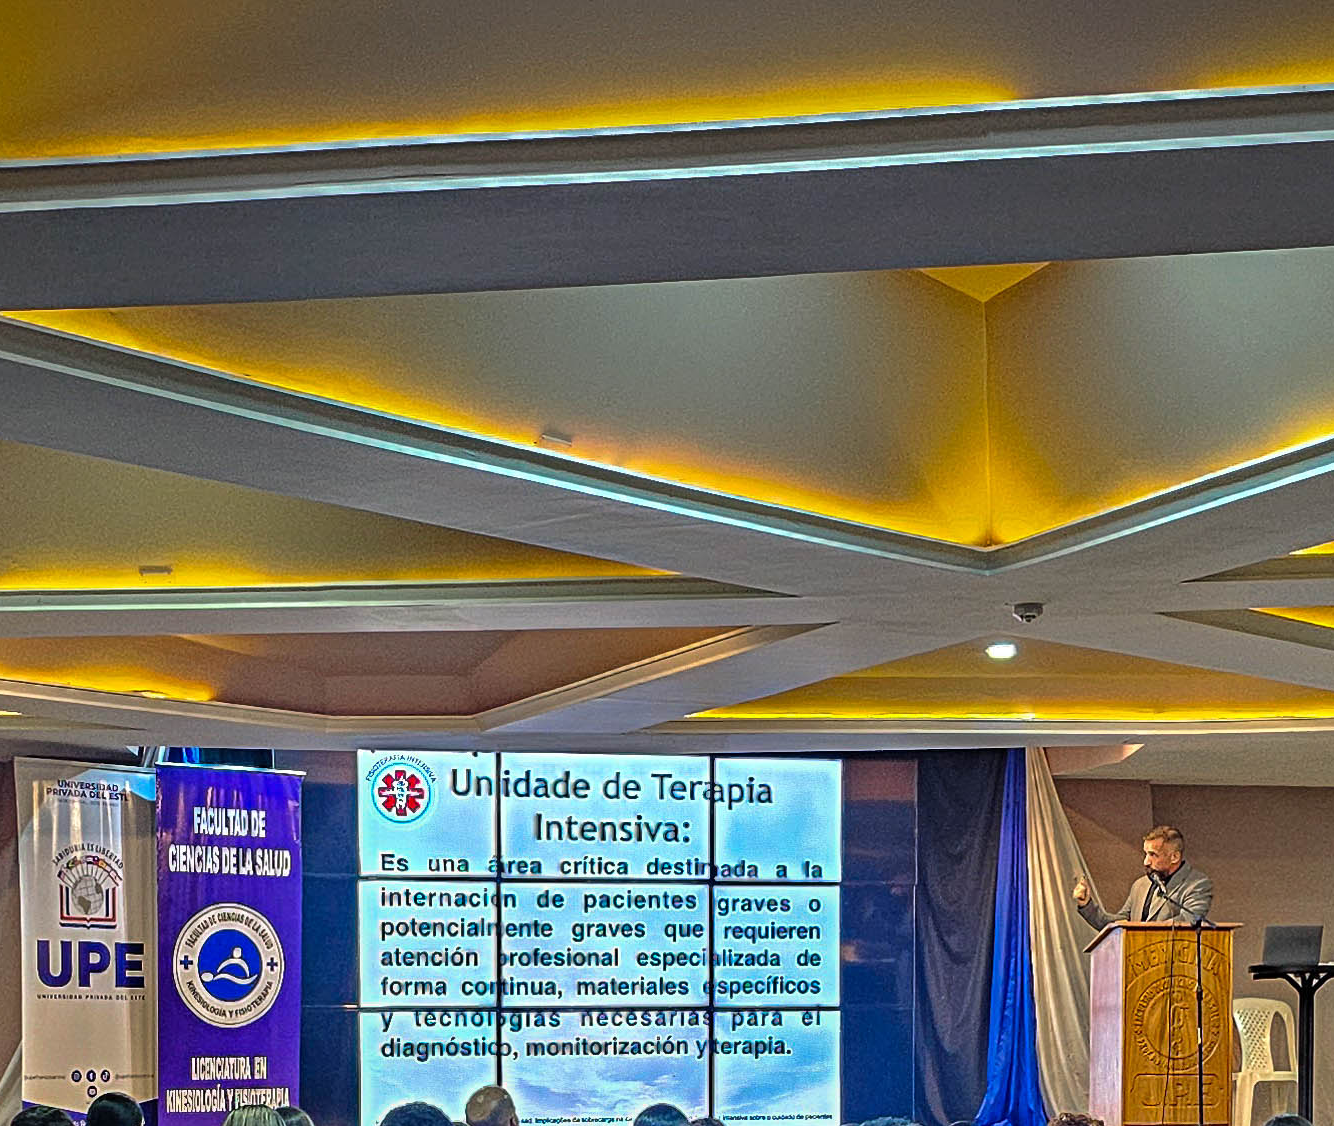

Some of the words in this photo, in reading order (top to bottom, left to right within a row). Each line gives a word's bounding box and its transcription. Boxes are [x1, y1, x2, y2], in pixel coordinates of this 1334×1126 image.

[46, 787, 87, 799] PRIVADA
[57, 779, 119, 792] UNIVERSIDAD
[451, 768, 591, 799] Unidade
[602, 771, 642, 800] de
[650, 773, 774, 811] Terapia
[193, 806, 248, 836] FACULTAD
[250, 809, 266, 838] DE
[534, 813, 691, 843] Intensiva:
[168, 843, 220, 874] CIENCIAS
[221, 846, 237, 875] DE
[238, 847, 254, 876] LA
[255, 848, 291, 877] SALUD
[380, 853, 409, 872] Es
[428, 857, 470, 872] una
[560, 855, 629, 876] crítica
[646, 857, 759, 879] destinada
[775, 864, 788, 878] a
[804, 860, 823, 879] la
[536, 889, 565, 909] de
[583, 889, 697, 913] pacientes
[717, 897, 792, 916] graves
[808, 898, 822, 913] o
[380, 917, 554, 942] potencialmente
[571, 922, 646, 943] graves
[664, 922, 705, 943] que
[723, 921, 821, 944] requieren
[36, 939, 145, 988] UPE
[380, 946, 479, 967] atención
[636, 947, 782, 971] especializada
[796, 948, 822, 967] de
[380, 976, 447, 996] forma
[461, 976, 564, 999] continua,
[576, 976, 690, 996] materiales
[702, 975, 822, 1000] específicos
[228, 1009, 234, 1018] Y
[380, 1011, 394, 1033] y
[581, 1009, 711, 1028] necesarias
[731, 1010, 784, 1032] para
[801, 1008, 822, 1027] el
[380, 1036, 519, 1063] diagnóstico,
[525, 1035, 690, 1057] monitorización
[695, 1039, 708, 1060] y
[713, 1035, 793, 1060] terapia.
[191, 1056, 252, 1081] LICENCIATURA
[254, 1056, 267, 1080] EN
[166, 1083, 227, 1113] KINESIOLOGÍA
[227, 1088, 234, 1112] Y
[234, 1087, 290, 1110] FISIOTERAPIA
